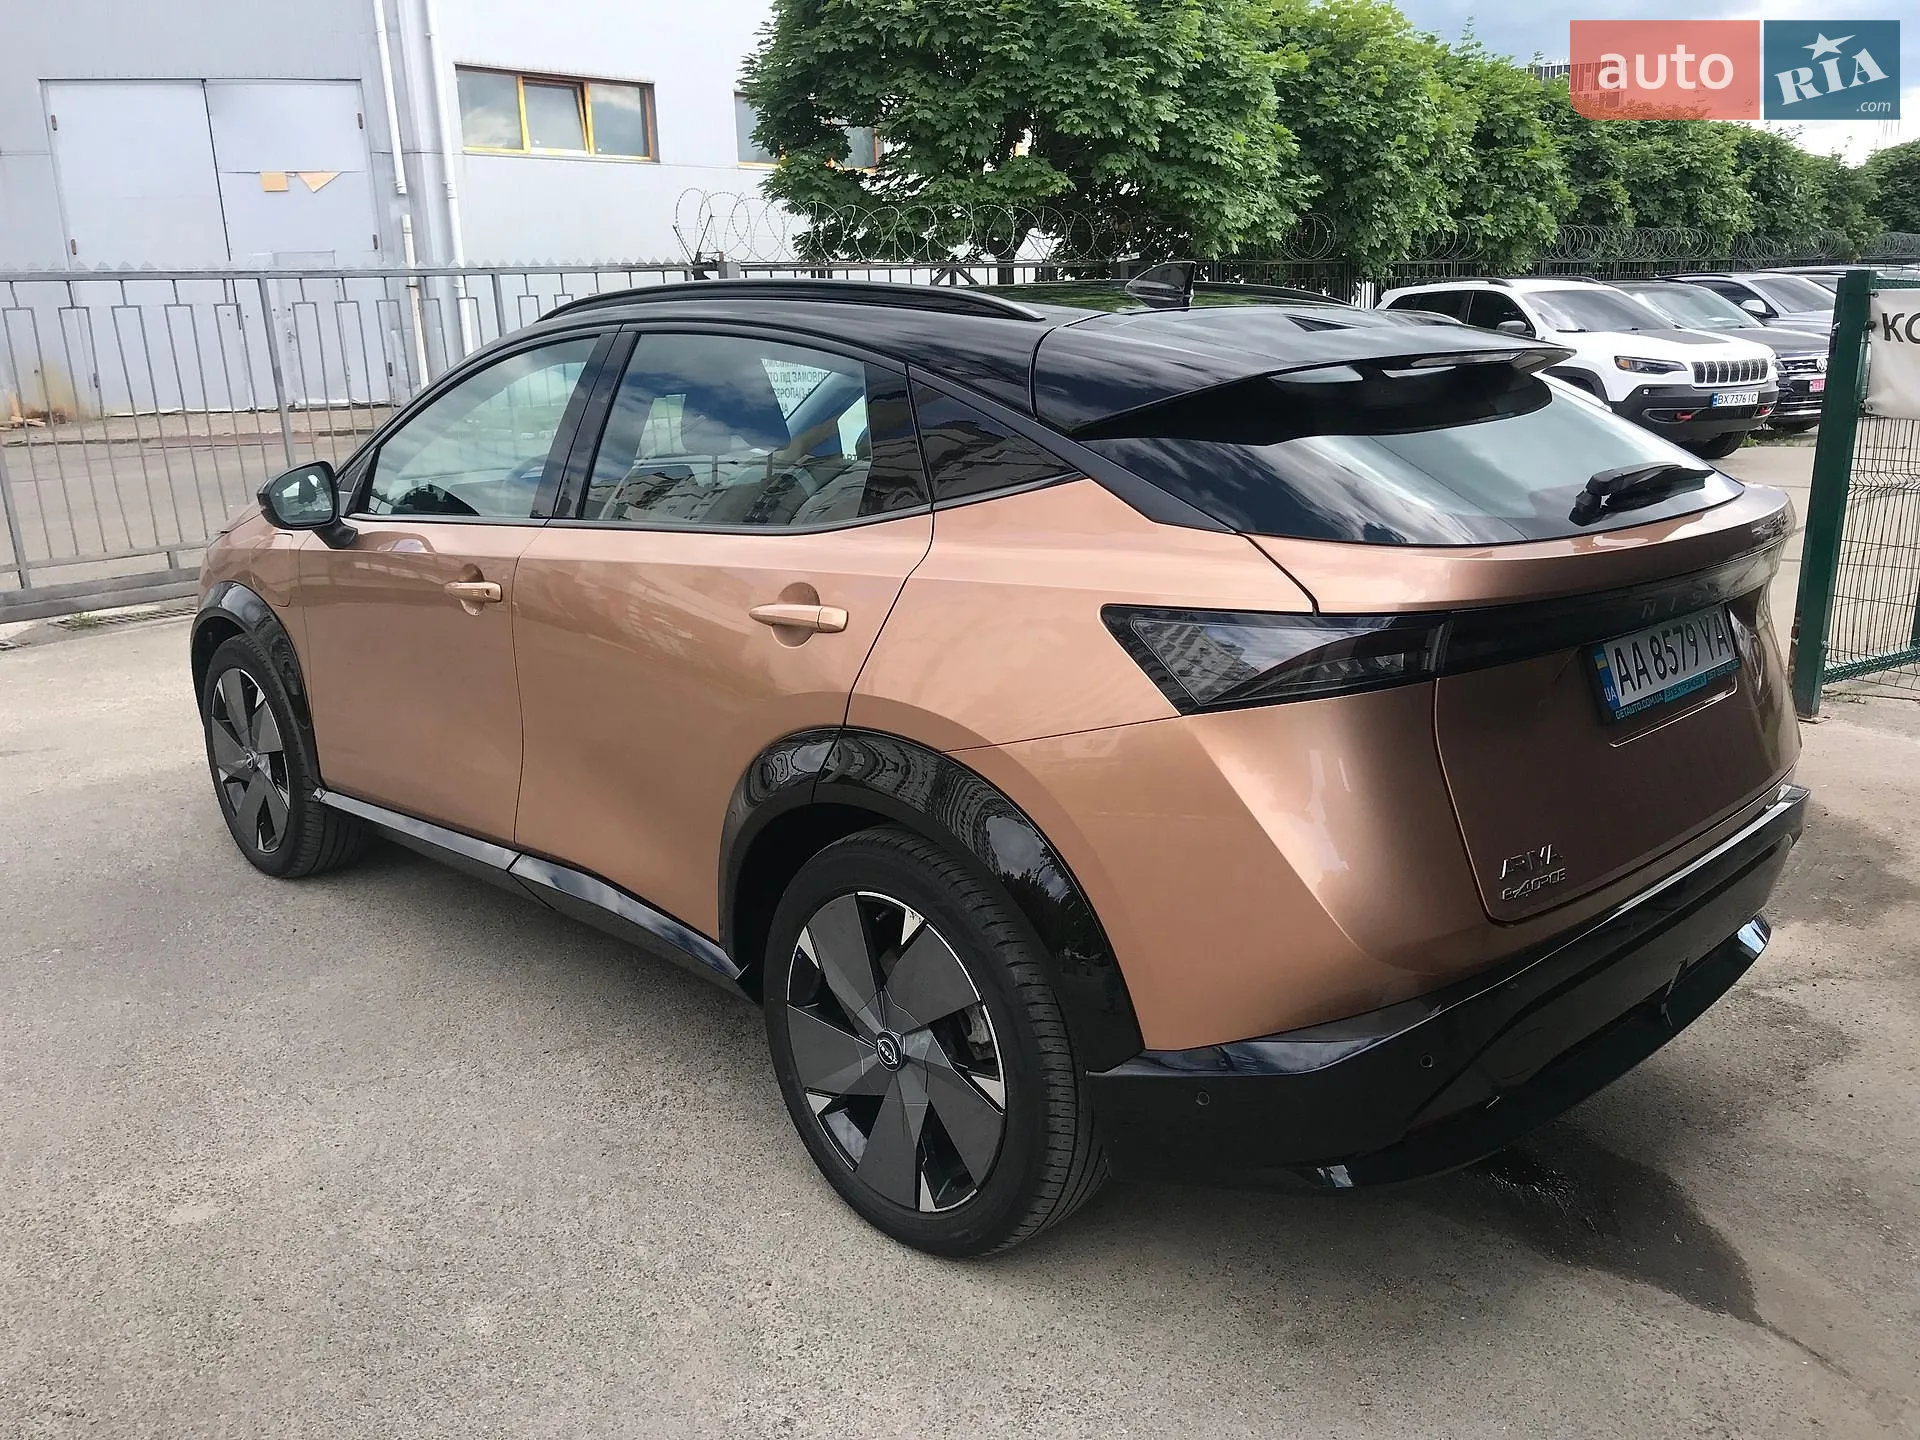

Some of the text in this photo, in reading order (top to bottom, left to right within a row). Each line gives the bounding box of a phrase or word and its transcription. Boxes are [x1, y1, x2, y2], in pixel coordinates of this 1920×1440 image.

[1730, 394, 1747, 404] 7376
[1614, 611, 1731, 696] AA 8579 YA
[1604, 686, 1618, 702] UA
